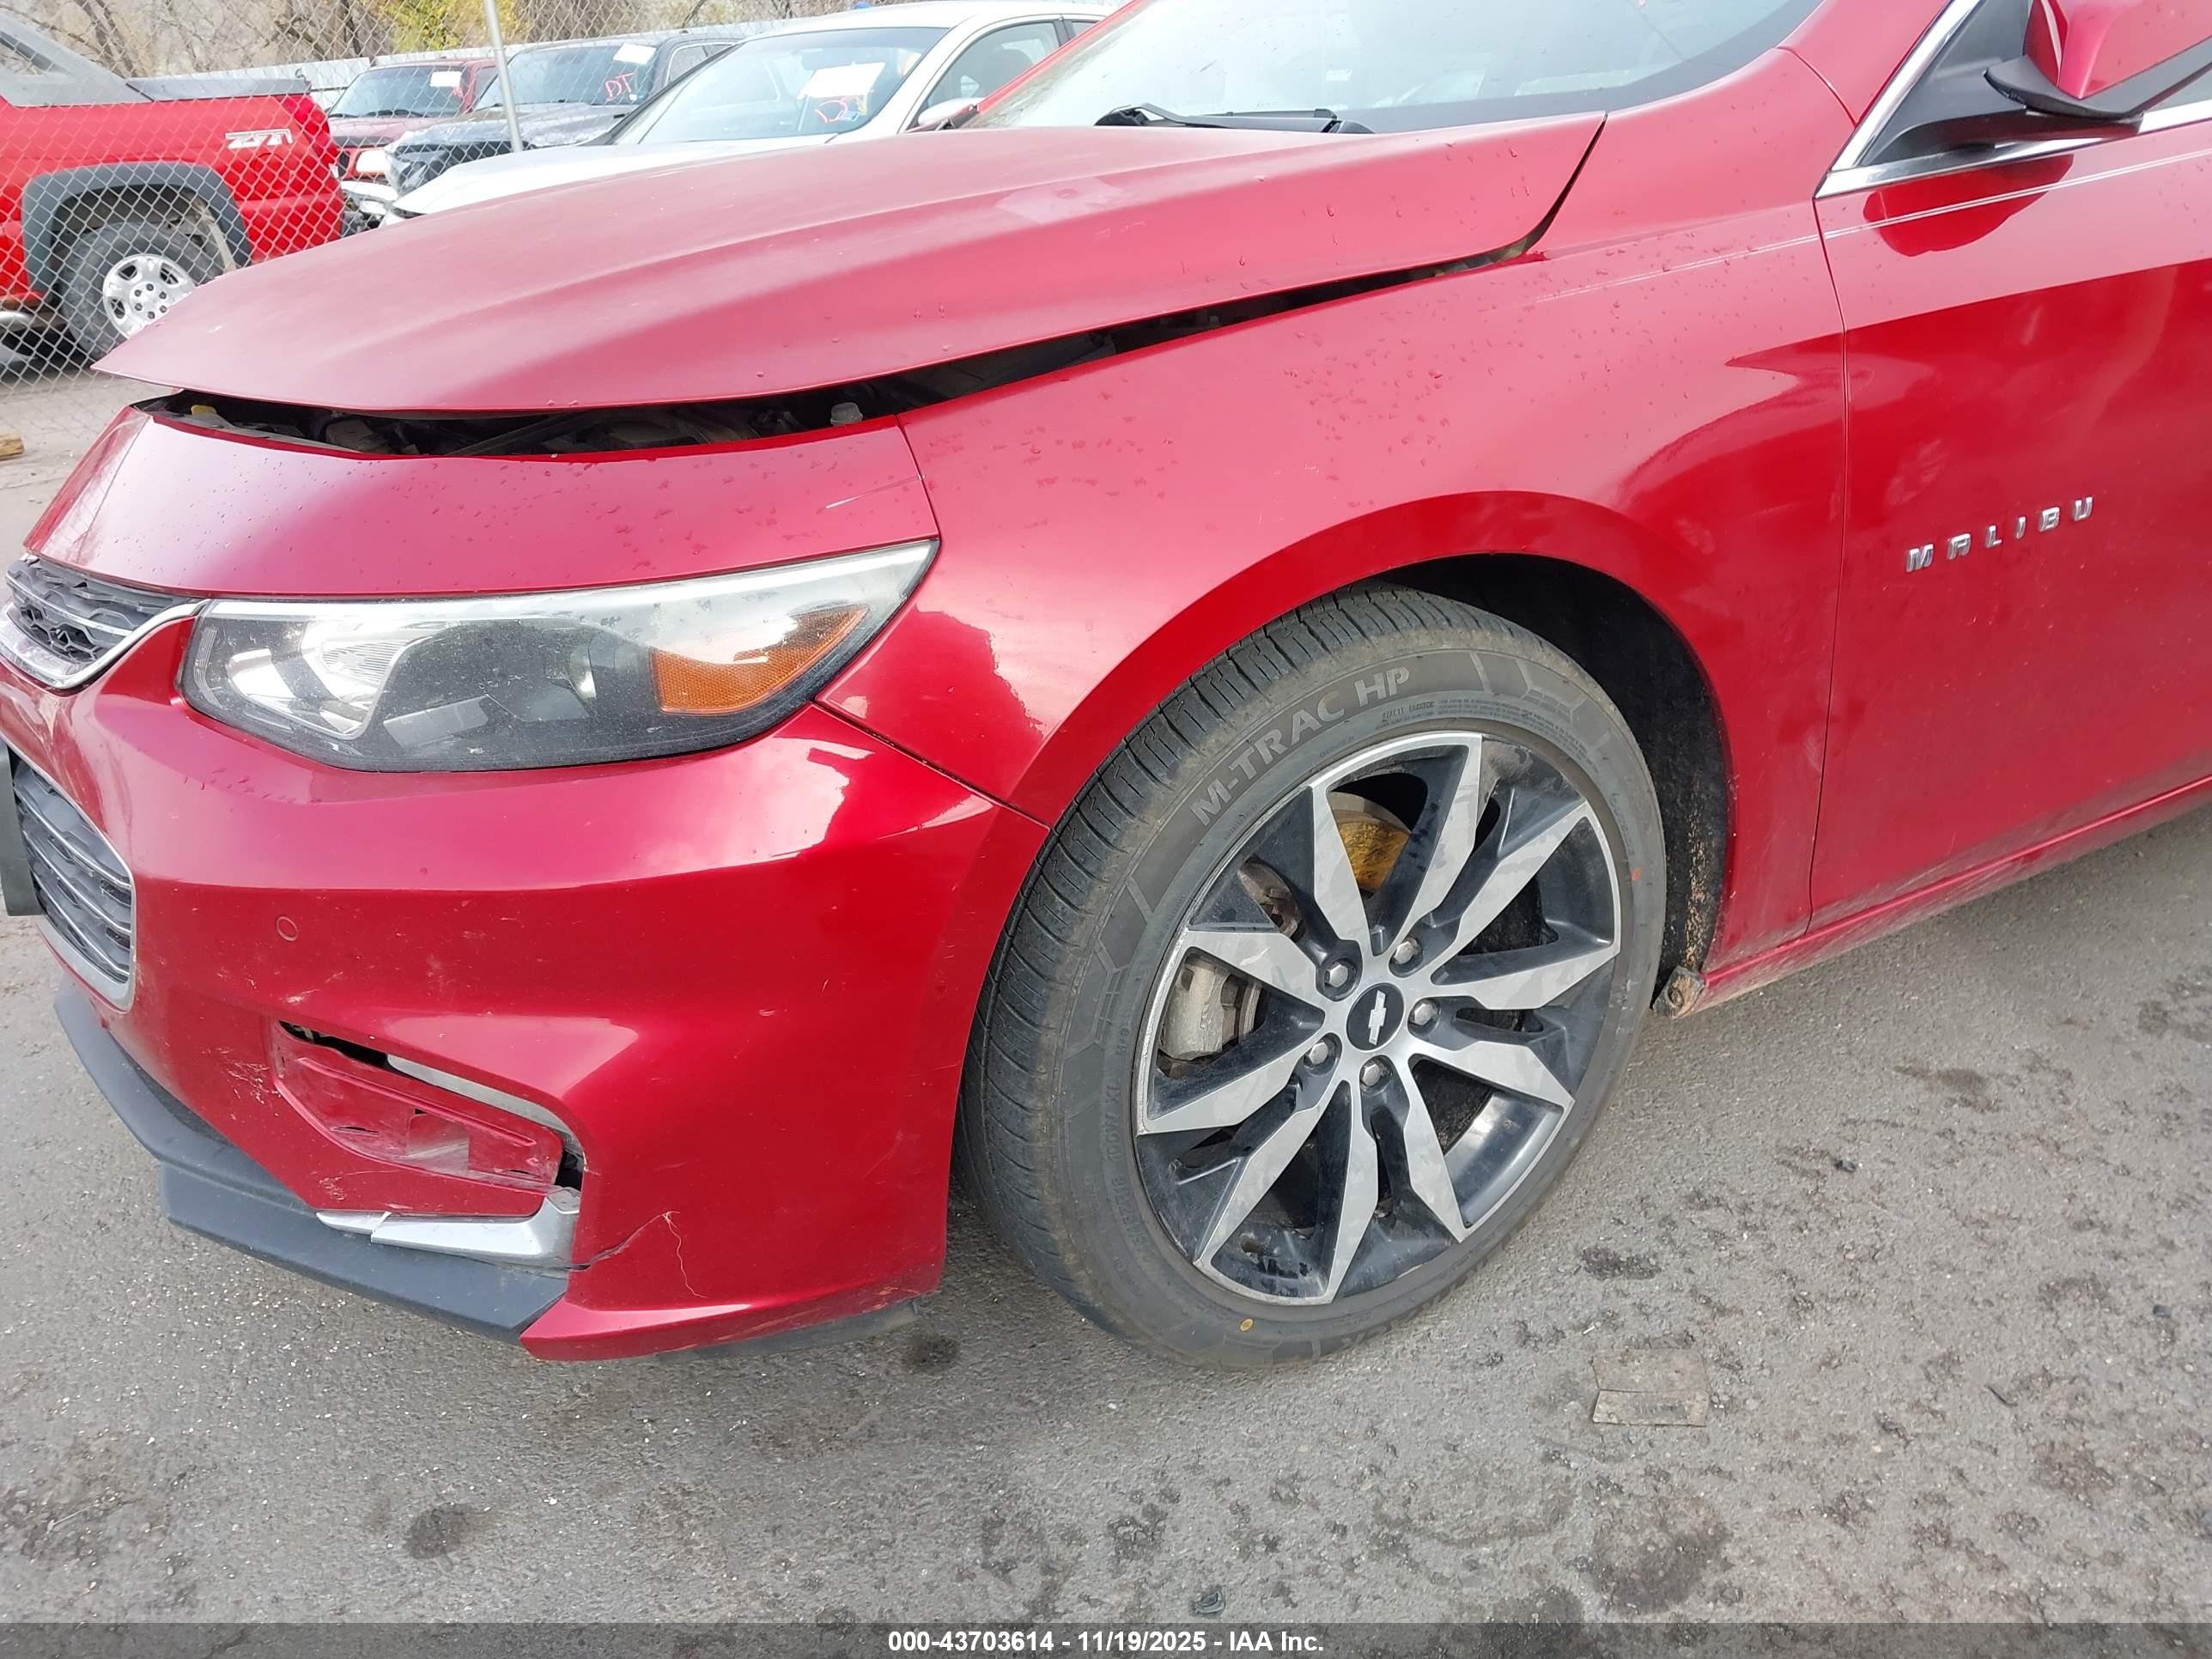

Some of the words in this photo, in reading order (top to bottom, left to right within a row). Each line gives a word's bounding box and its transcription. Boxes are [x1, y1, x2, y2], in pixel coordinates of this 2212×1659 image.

[1905, 496, 2094, 573] MALIBU
[1189, 690, 1345, 826] M-TRAC
[1354, 666, 1409, 708] HP
